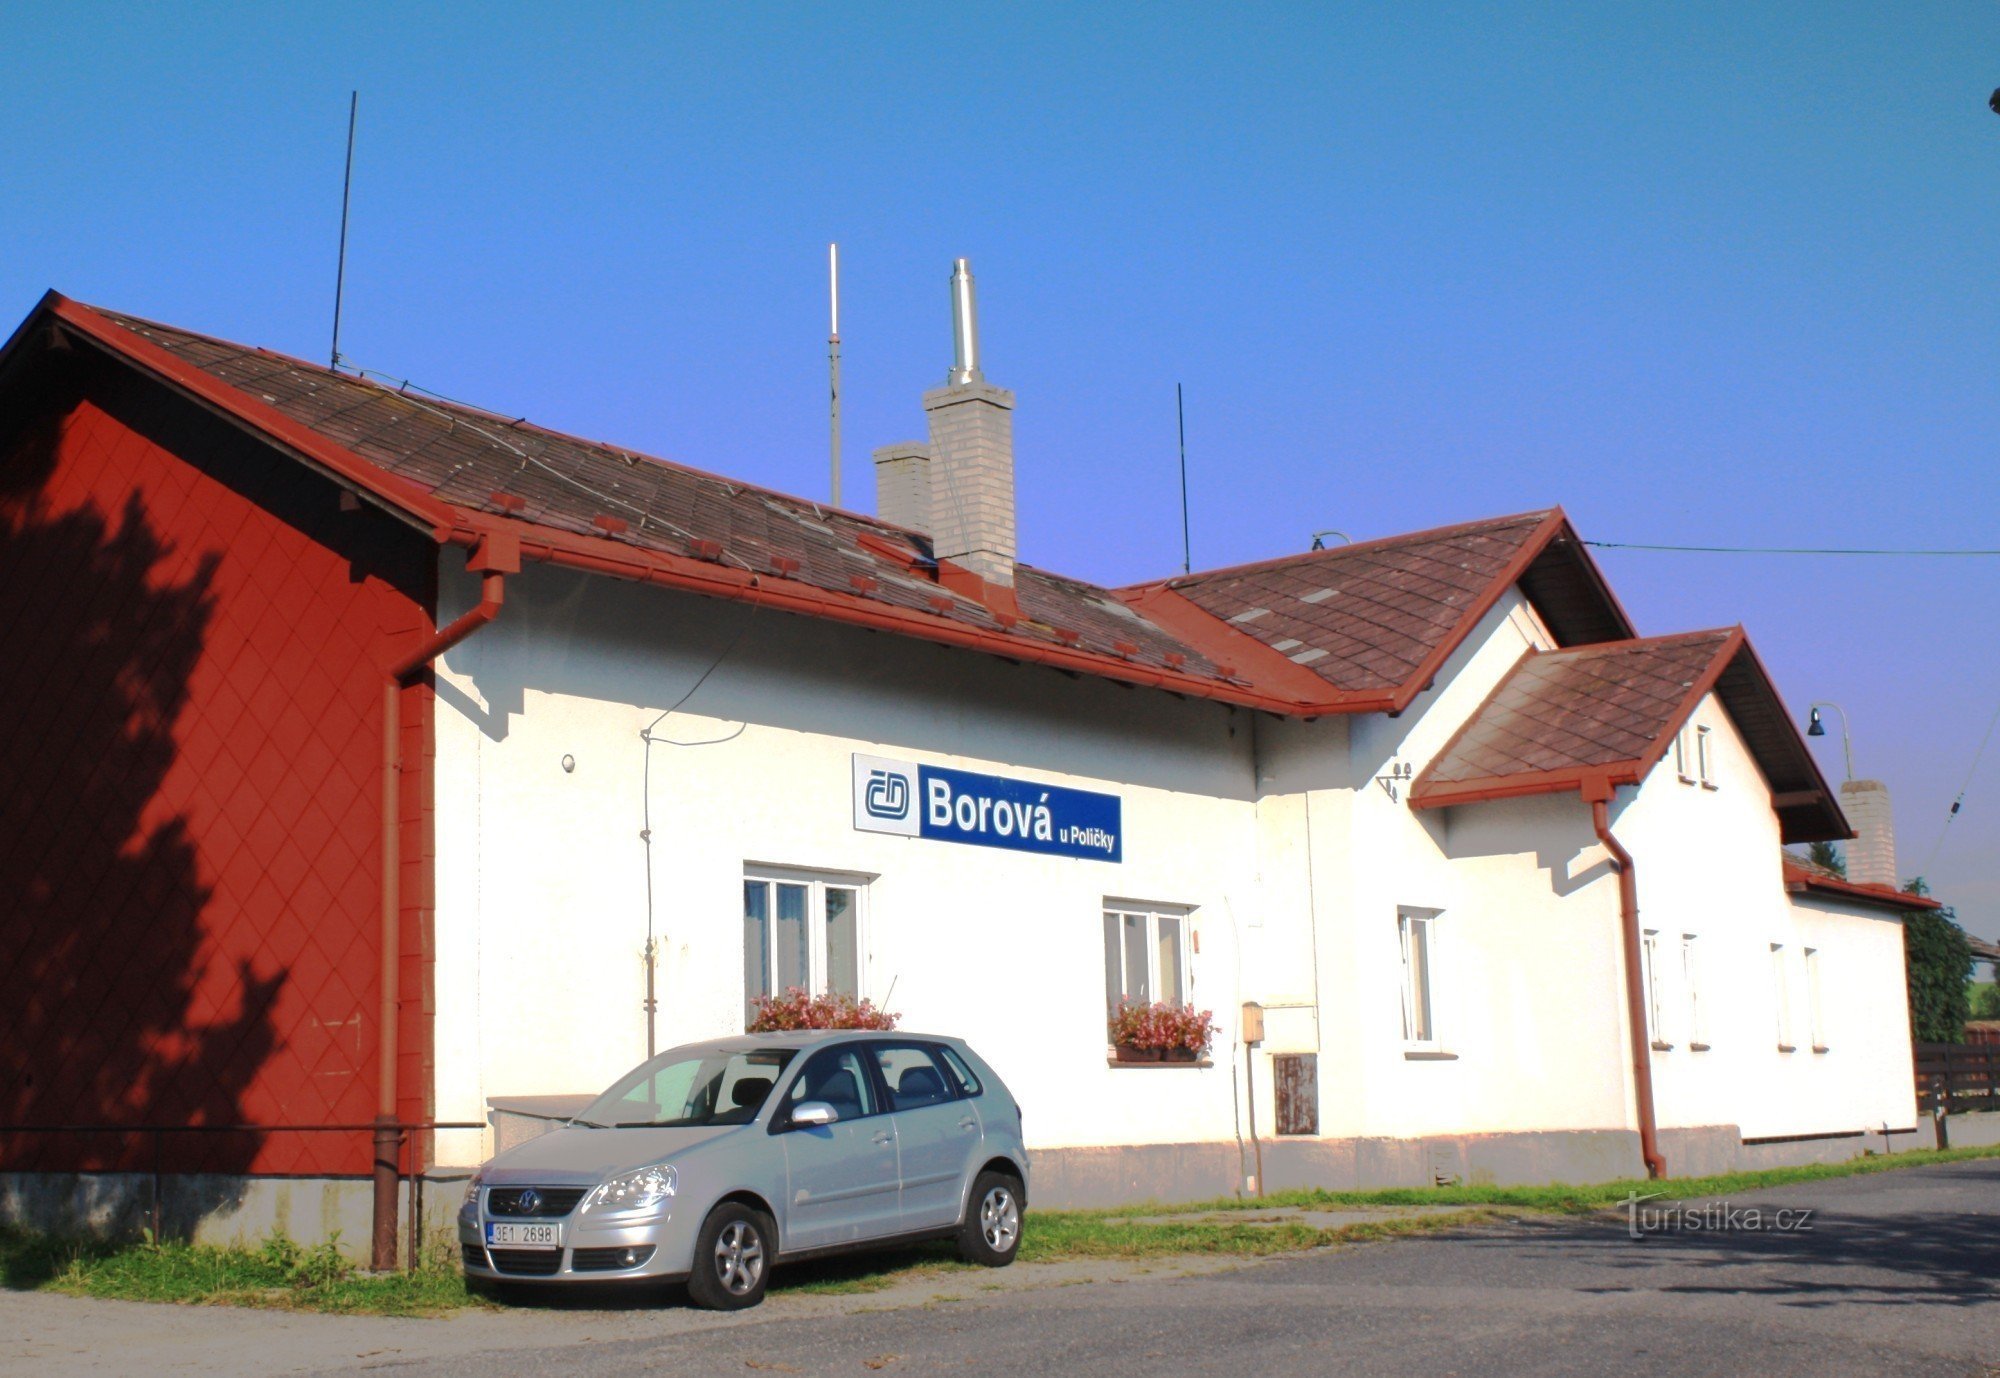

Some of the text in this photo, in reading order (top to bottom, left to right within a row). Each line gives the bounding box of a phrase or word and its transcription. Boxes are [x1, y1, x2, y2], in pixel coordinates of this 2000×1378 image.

[928, 777, 1115, 853] Borová u Poličky
[495, 1226, 515, 1241] 3E1
[523, 1226, 552, 1242] 2698
